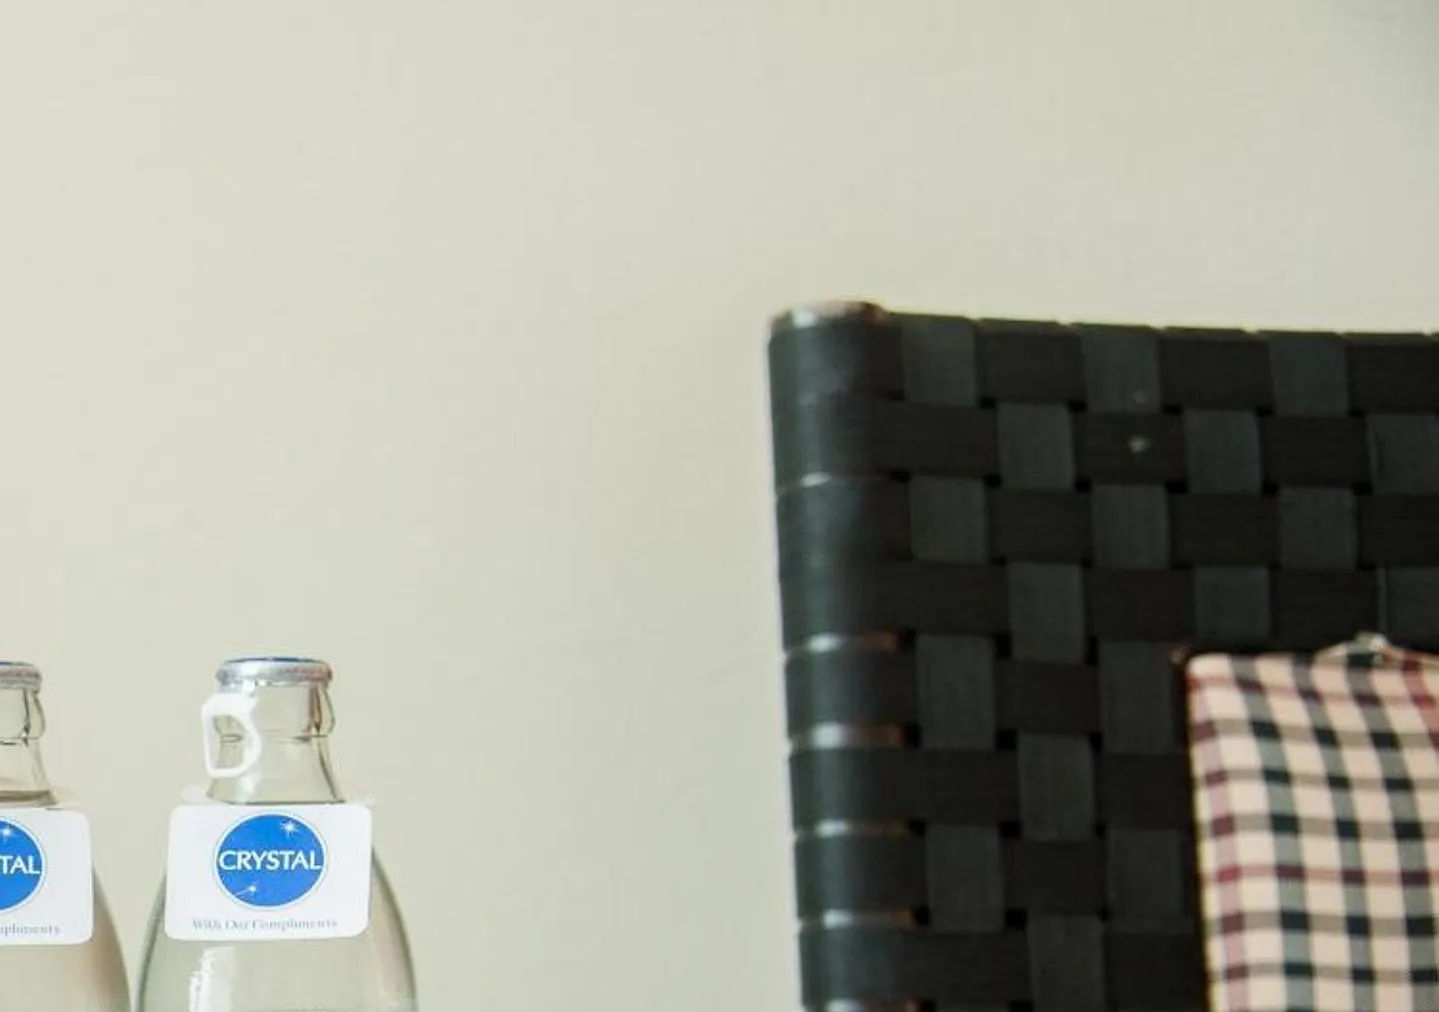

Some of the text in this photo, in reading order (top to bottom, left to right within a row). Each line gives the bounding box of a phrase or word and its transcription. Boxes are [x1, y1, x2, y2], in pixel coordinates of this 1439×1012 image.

[218, 849, 322, 871] CRYSTAL
[192, 916, 338, 933] With Our Compliments
